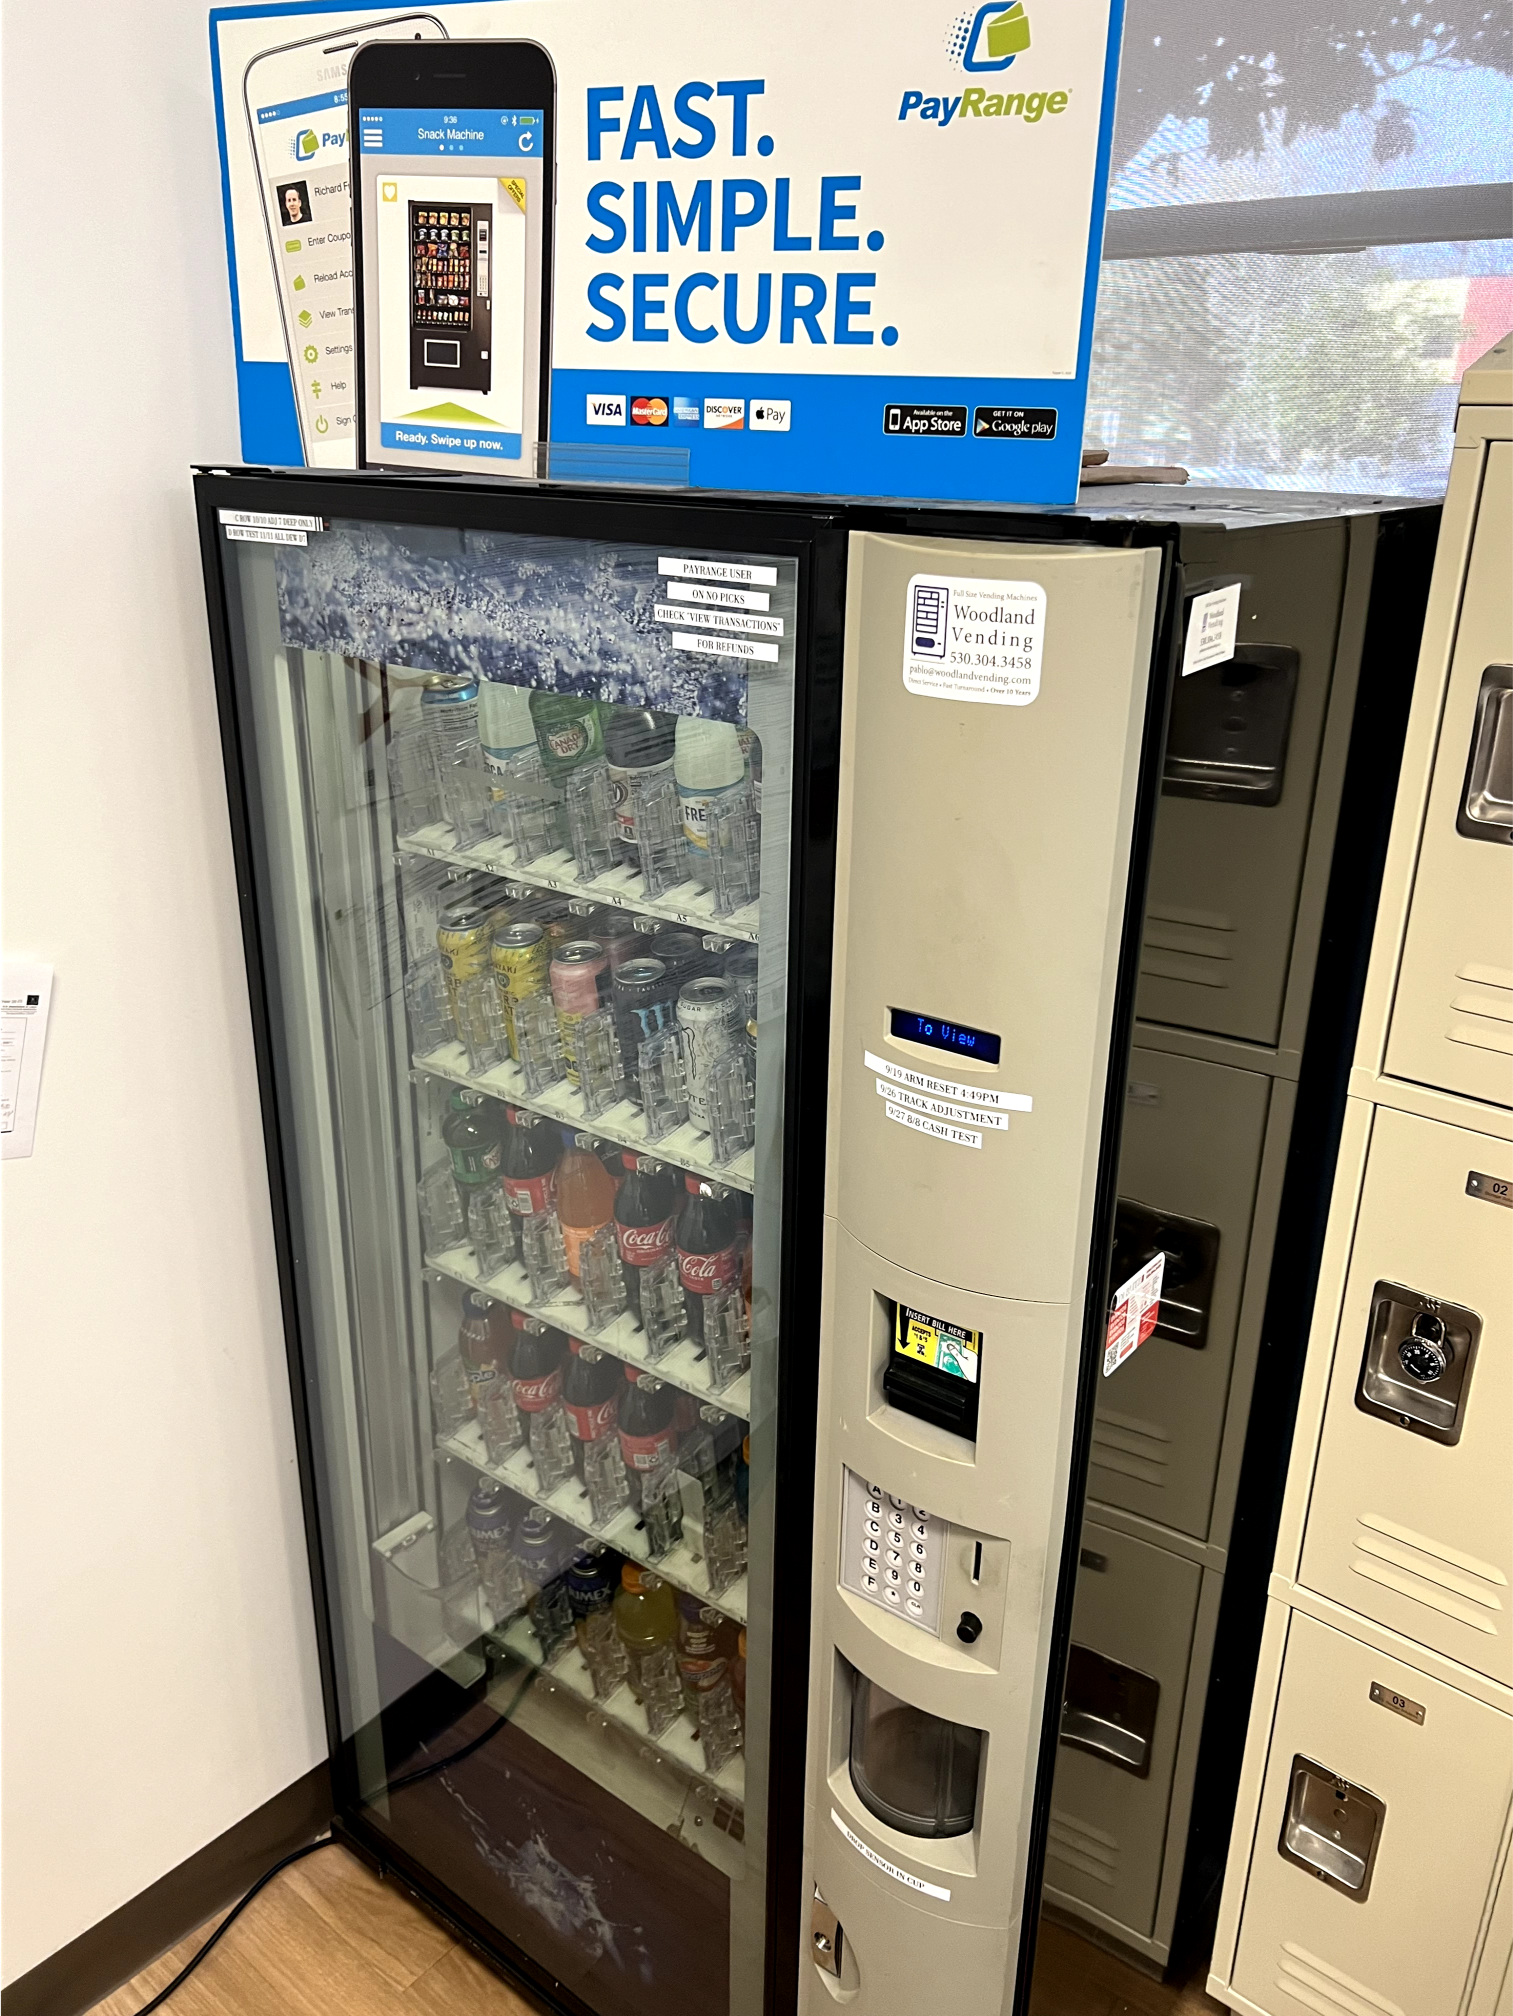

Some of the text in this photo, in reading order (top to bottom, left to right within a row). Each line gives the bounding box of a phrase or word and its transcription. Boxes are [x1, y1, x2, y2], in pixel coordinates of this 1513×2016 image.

[898, 87, 1069, 127] PayRange
[443, 115, 457, 124] 9:36
[586, 79, 775, 161] FAST.
[322, 128, 350, 148] Pay
[418, 128, 484, 141] Snack Machine
[314, 183, 343, 197] Richard
[585, 175, 885, 254] SIMPLE.
[308, 234, 326, 247] Enter
[314, 271, 338, 284] Reload
[319, 309, 336, 320] View
[585, 271, 900, 347] SECURE.
[325, 343, 353, 356] Settings
[331, 381, 347, 391] Help
[591, 402, 622, 416] VISA
[632, 406, 668, 417] MasterCard
[706, 405, 742, 415] DISCOVER
[766, 407, 786, 425] Pay
[336, 416, 352, 427] Sign
[903, 416, 962, 433] App Store
[992, 420, 1053, 436] Google play
[395, 430, 503, 451] Ready. Swipe up now.
[283, 518, 296, 527] DEEP
[298, 519, 313, 528] ONLY
[245, 530, 259, 539] TEST
[274, 532, 285, 541] ALL
[683, 563, 752, 580] PAYRANGE USER
[692, 589, 745, 604] ON NO PICKS
[953, 589, 965, 597] Full
[978, 591, 1005, 602] Vending
[1006, 593, 1038, 602] Machines
[657, 608, 781, 632] CHECK "VIEW TRANSACTIONS"
[954, 604, 1035, 625] Woodland
[697, 638, 755, 656] FOR REFUNDS
[952, 626, 1034, 653] Vending
[950, 651, 1032, 670] 530.304.3458
[909, 664, 1031, 686] pablo@woodlandvending.com
[908, 677, 922, 685] Direct
[922, 679, 939, 688] Service
[954, 683, 985, 693] Turnaround
[990, 687, 1005, 695] Over
[560, 740, 580, 755] DRY
[611, 897, 623, 906] A4
[676, 914, 688, 923] A5
[748, 932, 760, 942] A6
[917, 1018, 976, 1047] To View
[885, 1064, 999, 1105] 9/19 ARM RESET 4:49PM
[880, 1083, 1003, 1126] 9/26 TRACK ADJUSTMENT
[888, 1106, 979, 1145] 9/27 8/8 CASH TEST
[1492, 1182, 1508, 1196] 02
[905, 1307, 967, 1339] INSERT BILL HERE
[872, 1485, 882, 1495] A
[871, 1502, 925, 1536] B 3 4
[870, 1521, 924, 1555] C 5 6
[869, 1540, 922, 1575] D 7 8
[868, 1576, 876, 1587] F
[869, 1559, 921, 1592] E 9 0
[911, 1601, 921, 1609] CLR
[1392, 1695, 1406, 1709] 03
[846, 1830, 925, 1889] DROP SENSOR IN CUP
